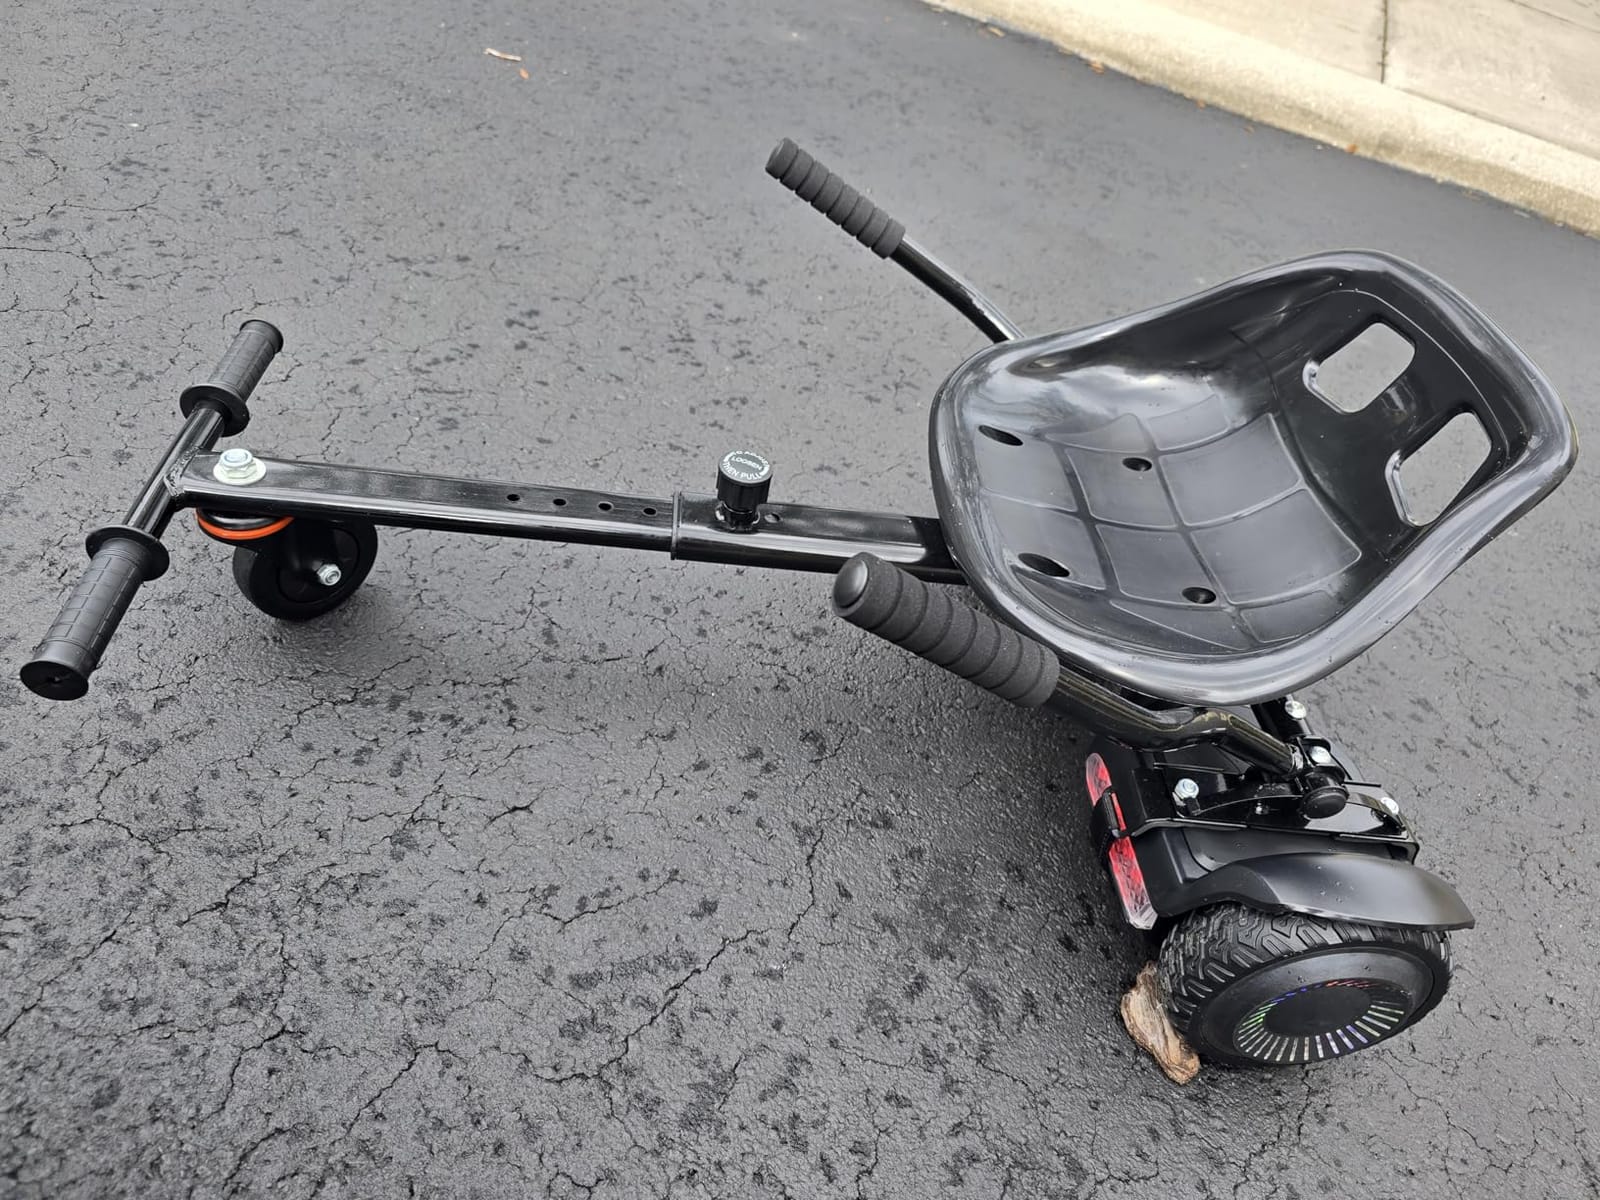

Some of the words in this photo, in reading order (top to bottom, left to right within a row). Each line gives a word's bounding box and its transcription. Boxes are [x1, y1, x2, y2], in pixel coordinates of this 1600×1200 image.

[722, 461, 740, 476] THEN
[740, 472, 762, 480] PULL
[731, 456, 763, 470] LOOSEN
